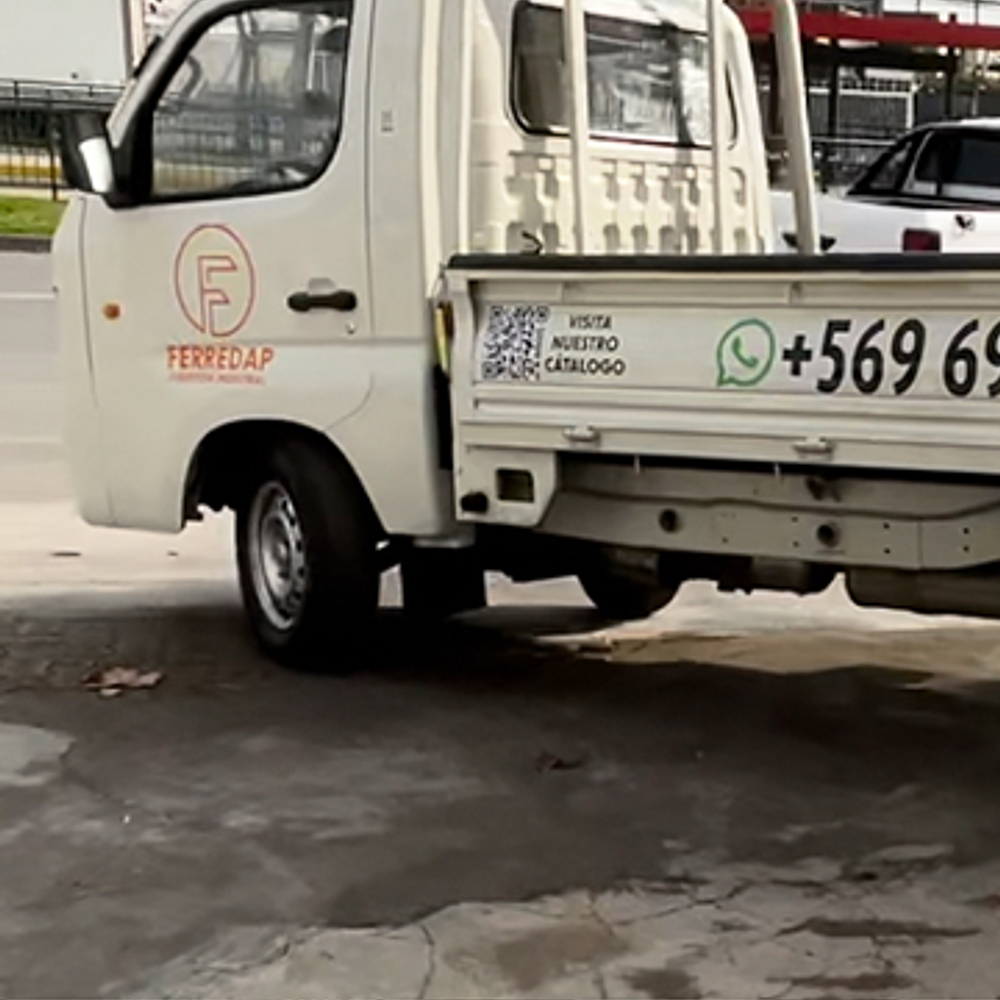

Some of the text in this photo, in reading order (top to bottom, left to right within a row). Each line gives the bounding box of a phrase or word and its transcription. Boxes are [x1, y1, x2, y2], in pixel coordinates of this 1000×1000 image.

[569, 313, 612, 330] VISITA
[551, 334, 620, 352] NUESTRO
[166, 344, 275, 371] FERREDAP
[544, 353, 627, 376] CÁTALOGO
[781, 317, 926, 397] +569
